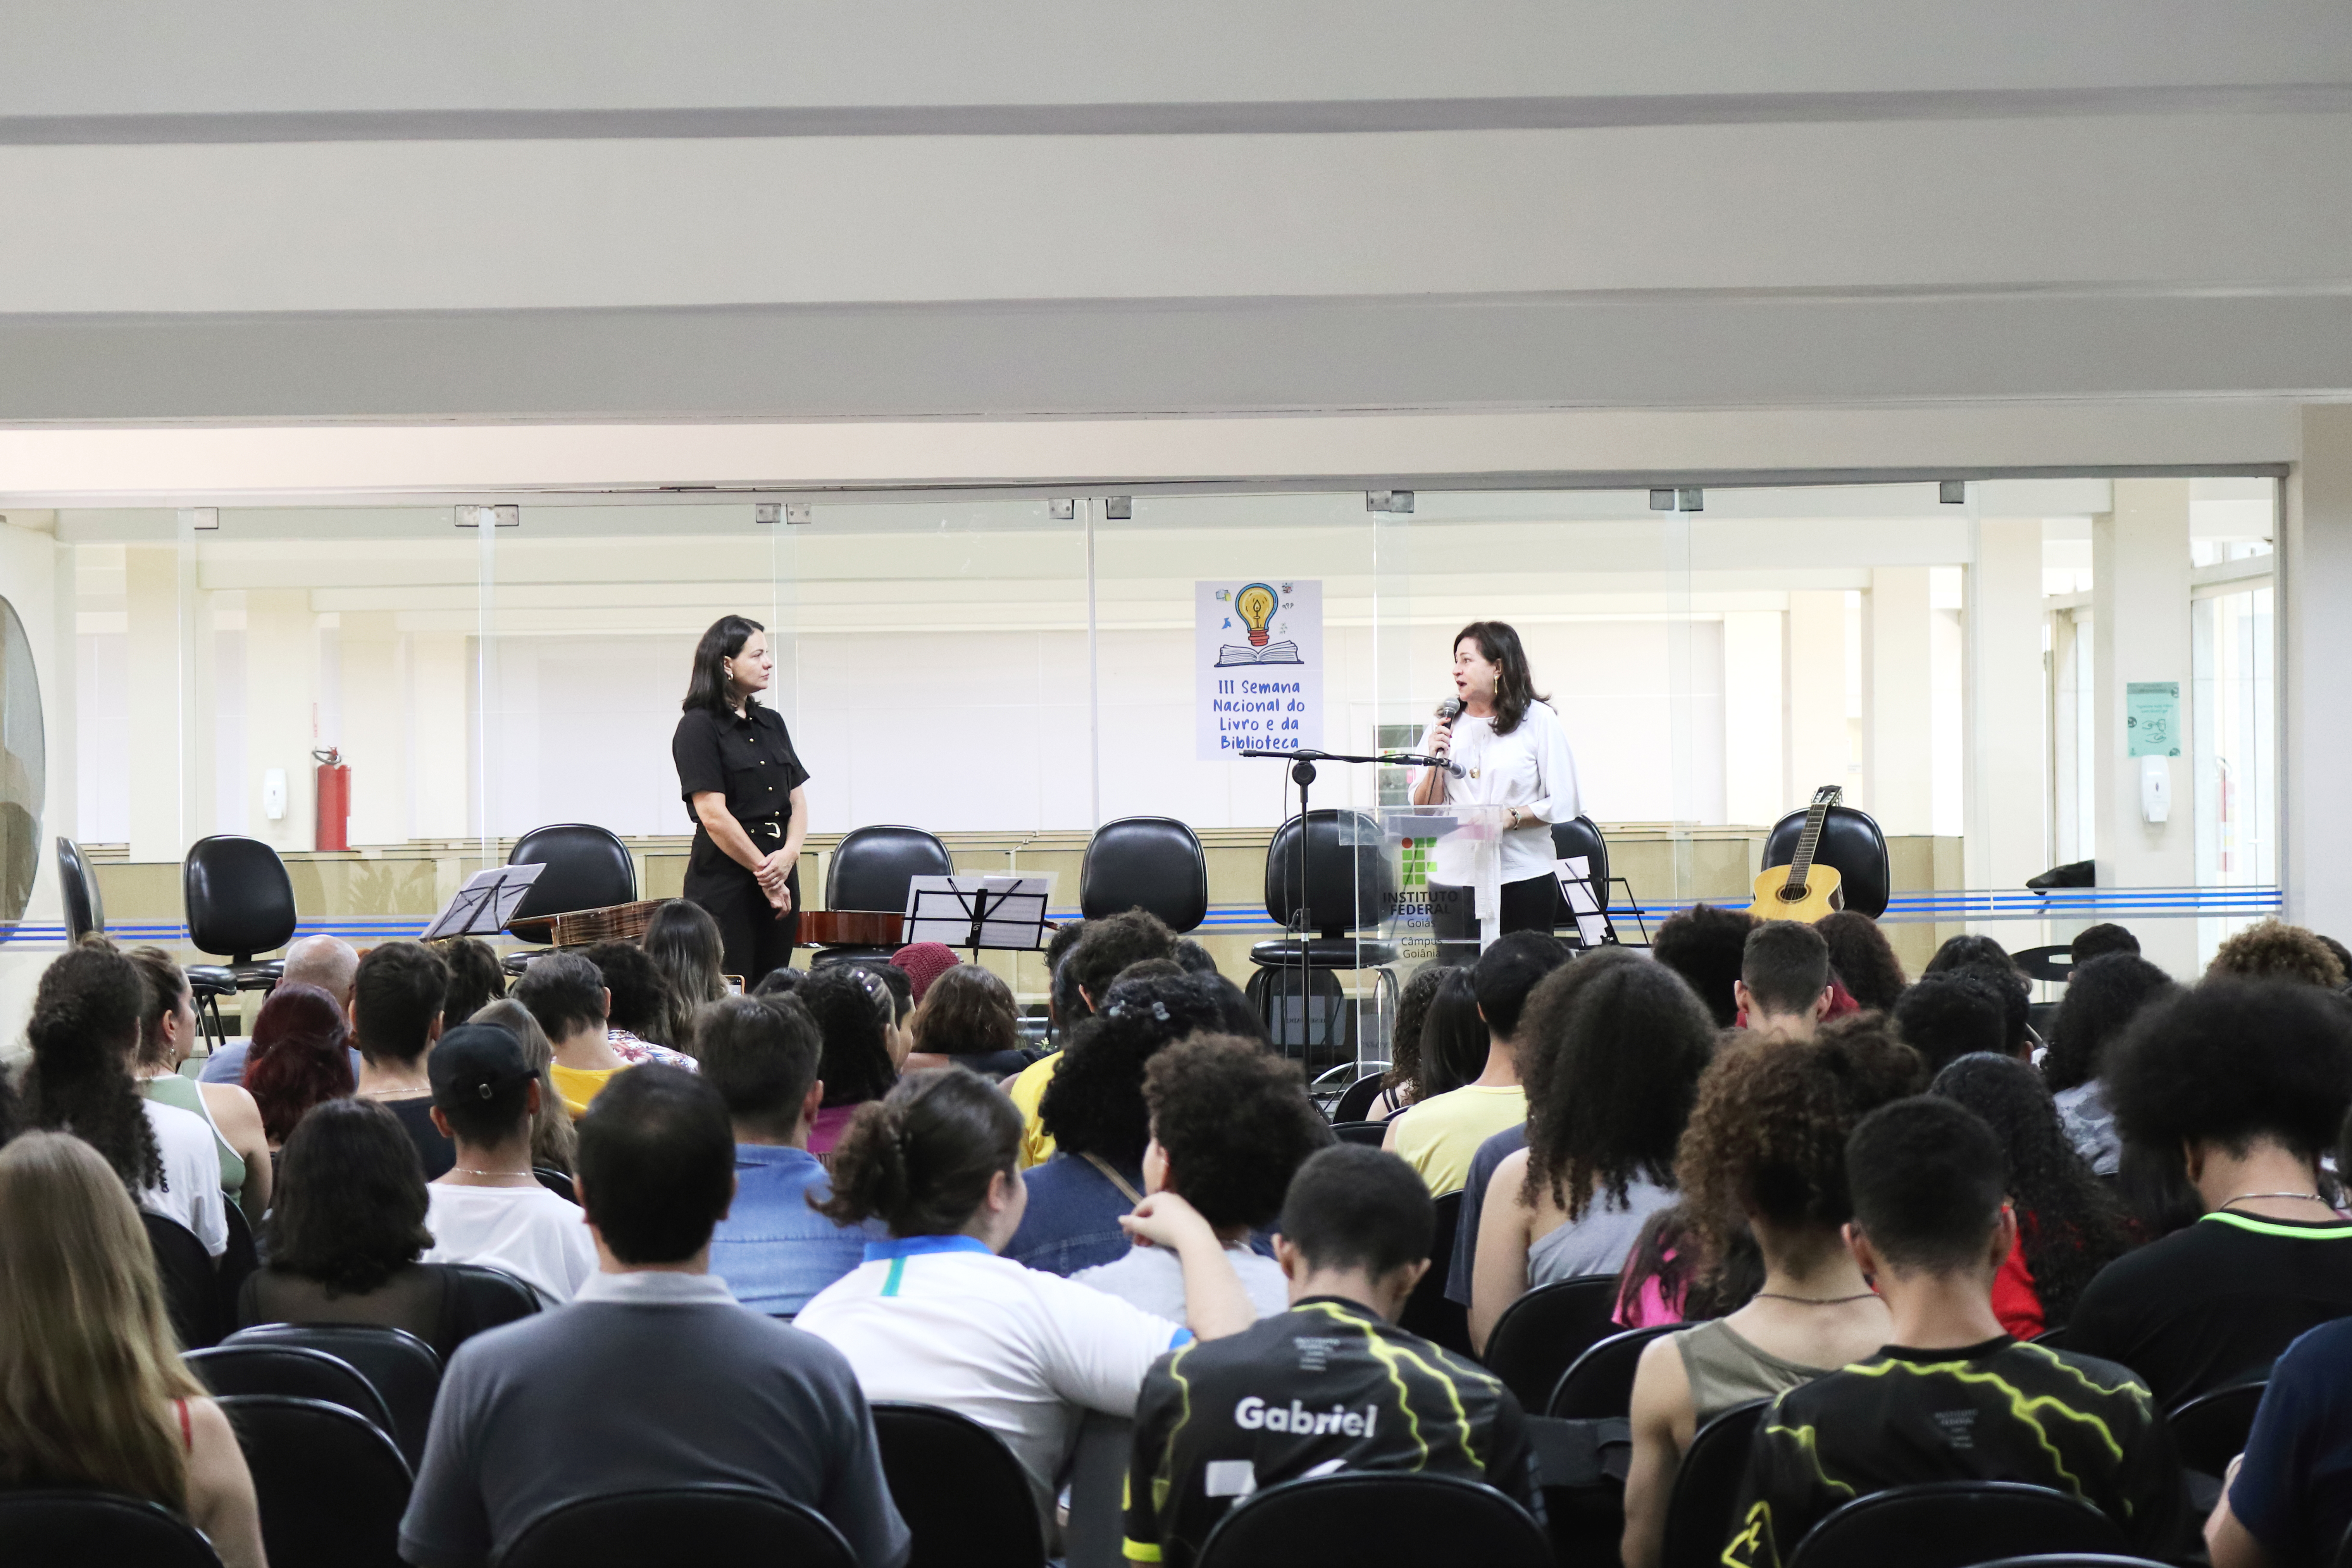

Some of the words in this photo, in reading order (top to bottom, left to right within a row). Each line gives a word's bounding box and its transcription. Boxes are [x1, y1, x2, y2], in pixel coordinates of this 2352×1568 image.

[1219, 680, 1234, 694] III
[1242, 680, 1300, 694] Semana
[1213, 698, 1279, 712] Nacional
[1287, 698, 1305, 712] do
[1220, 717, 1259, 731] Livro
[1266, 719, 1273, 731] e
[1281, 717, 1299, 730] da
[1221, 735, 1299, 750] Biblioteca
[1383, 891, 1458, 903] INSTITUTO
[1391, 904, 1451, 915] FEDERAL
[1408, 918, 1435, 927] Goiás
[1401, 937, 1442, 947] Câmpus
[1403, 949, 1440, 958] Goiânia
[1234, 1396, 1378, 1438] Gabriel
